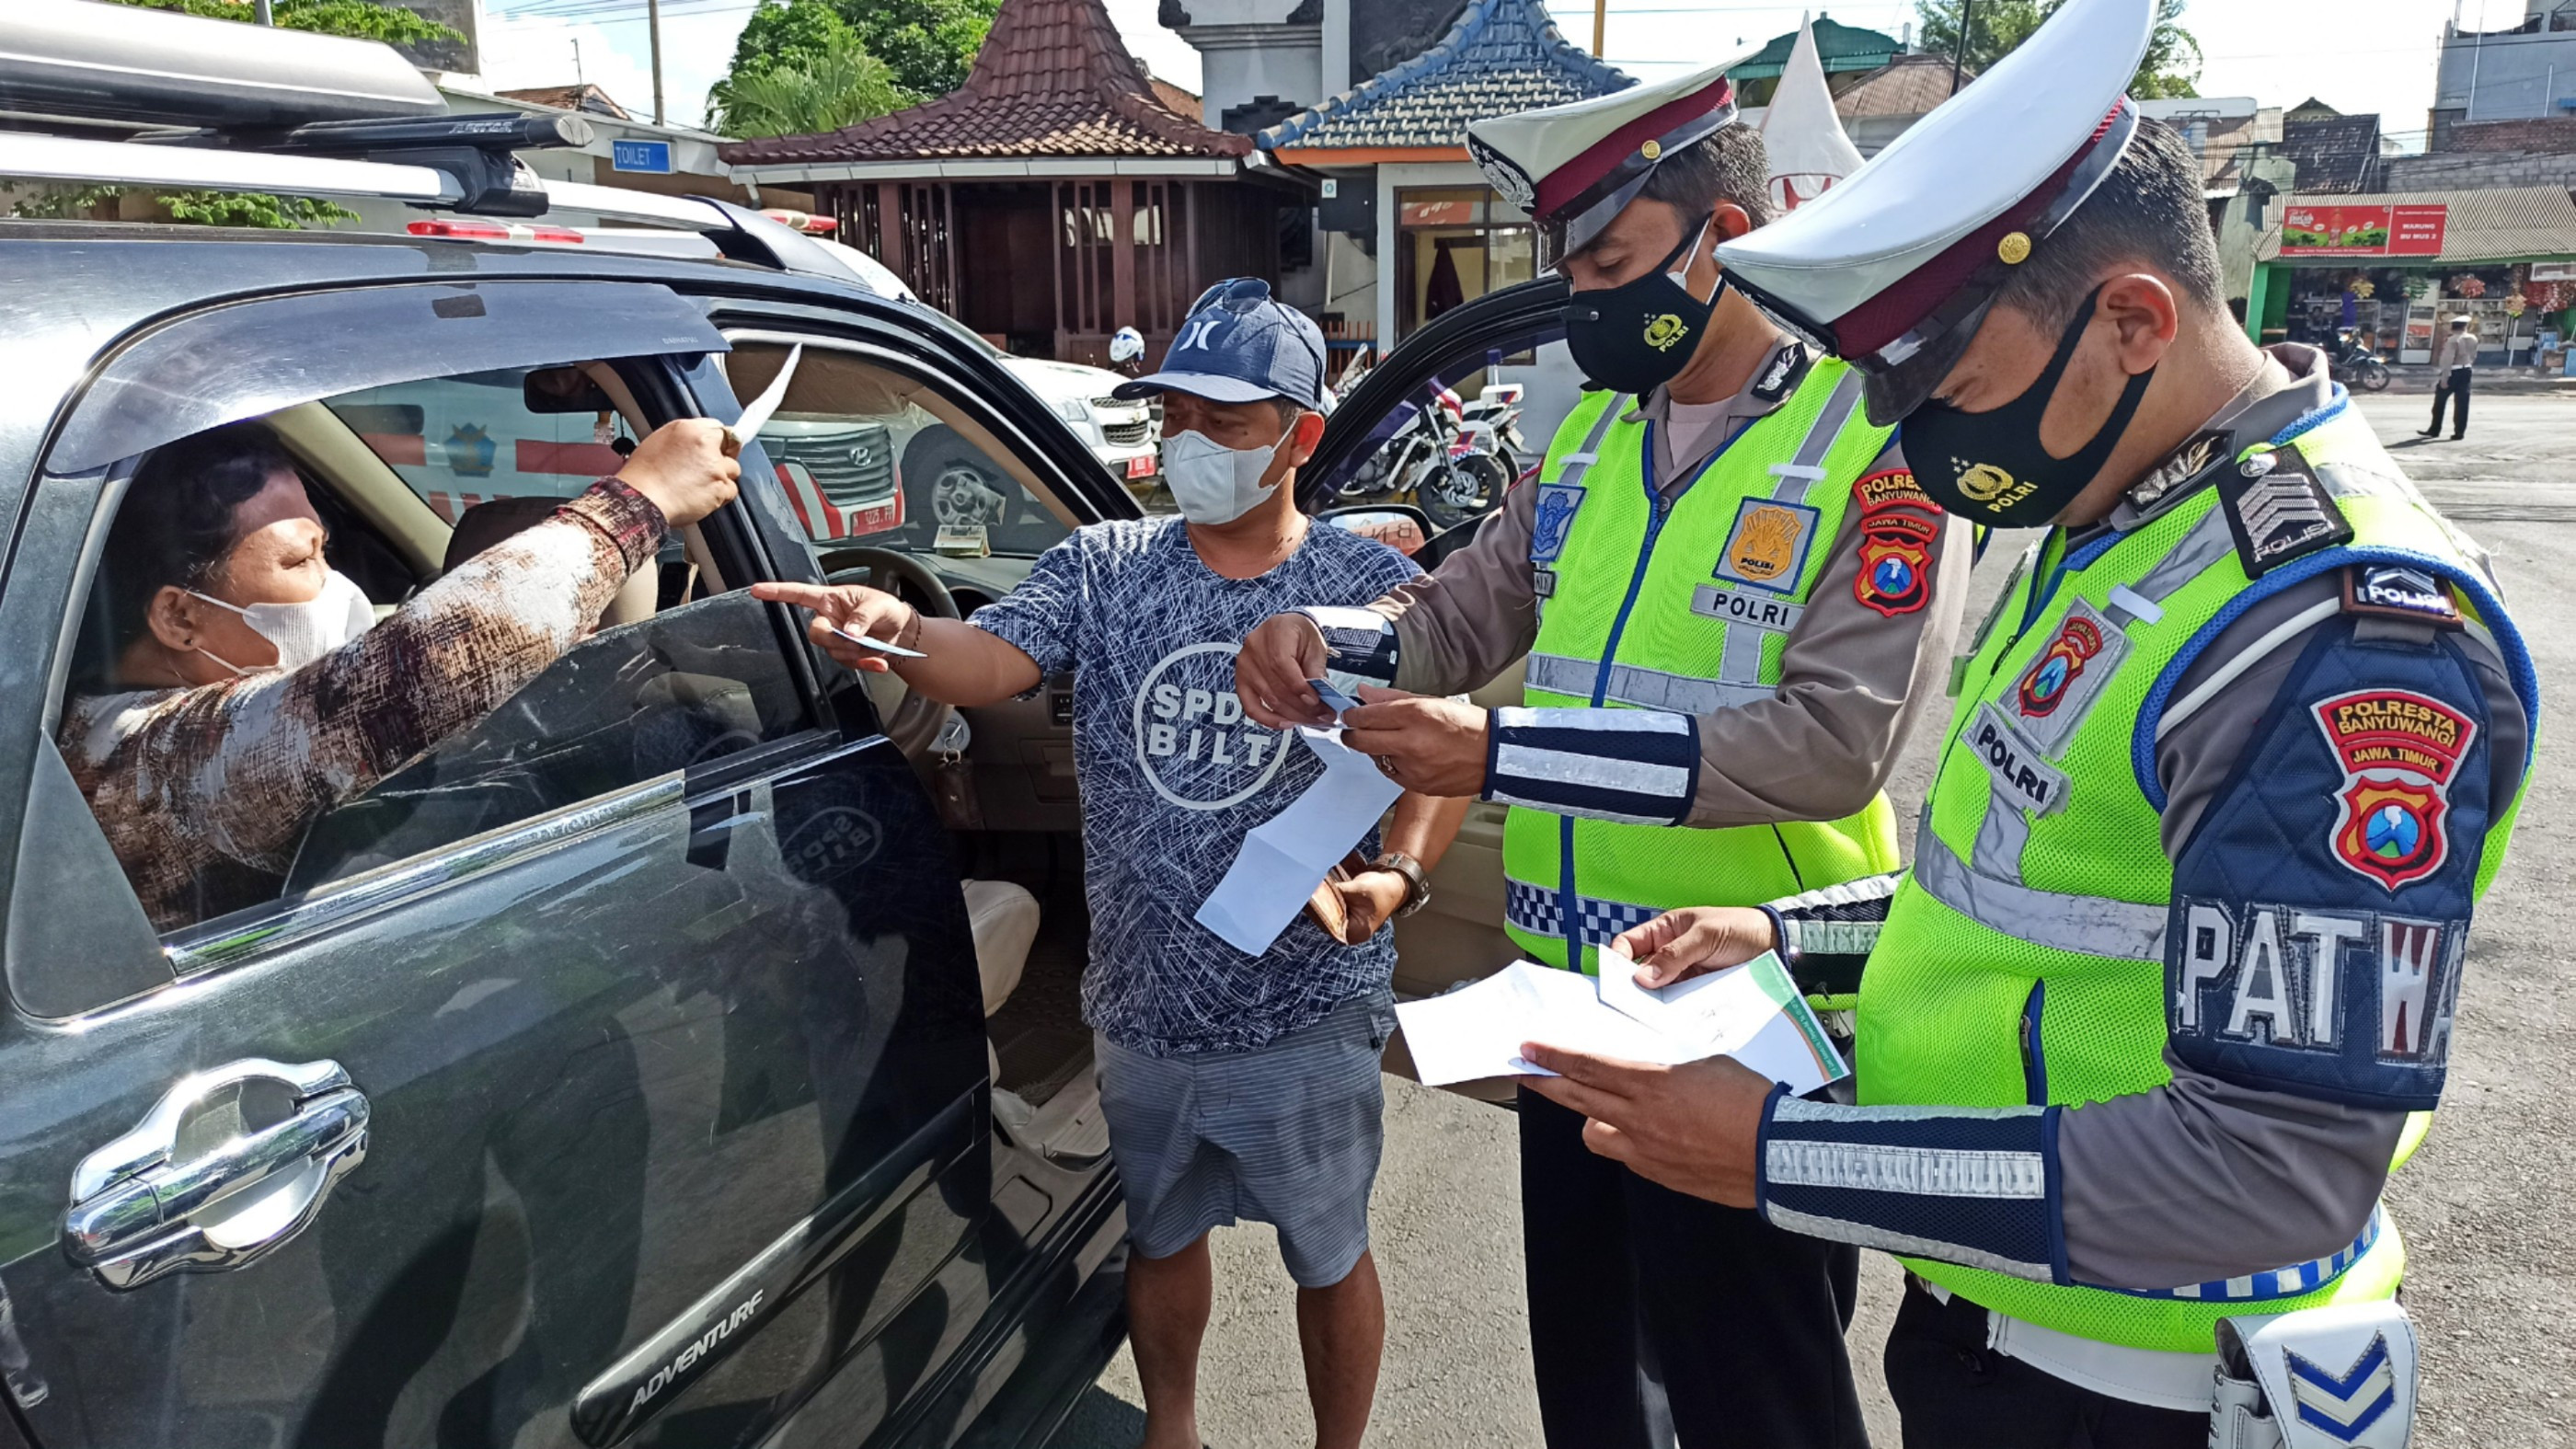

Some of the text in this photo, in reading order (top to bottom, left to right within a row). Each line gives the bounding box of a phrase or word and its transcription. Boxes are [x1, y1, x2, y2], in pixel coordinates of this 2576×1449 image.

[615, 146, 650, 165] TOILET
[1659, 325, 1689, 352] POLRI
[1987, 481, 2038, 512] POLRI
[1869, 518, 1930, 534] JAWA TIMUR
[1740, 557, 1775, 570] POLISI
[1712, 592, 1788, 627] POLRI
[1152, 684, 1269, 729] SPD
[2338, 700, 2456, 735] POLRESTA
[1148, 722, 1271, 766] BILT
[2338, 716, 2456, 748] BANYUWANGI
[1978, 723, 2049, 804] POLRI
[2353, 747, 2438, 771] JAWA TIMUR
